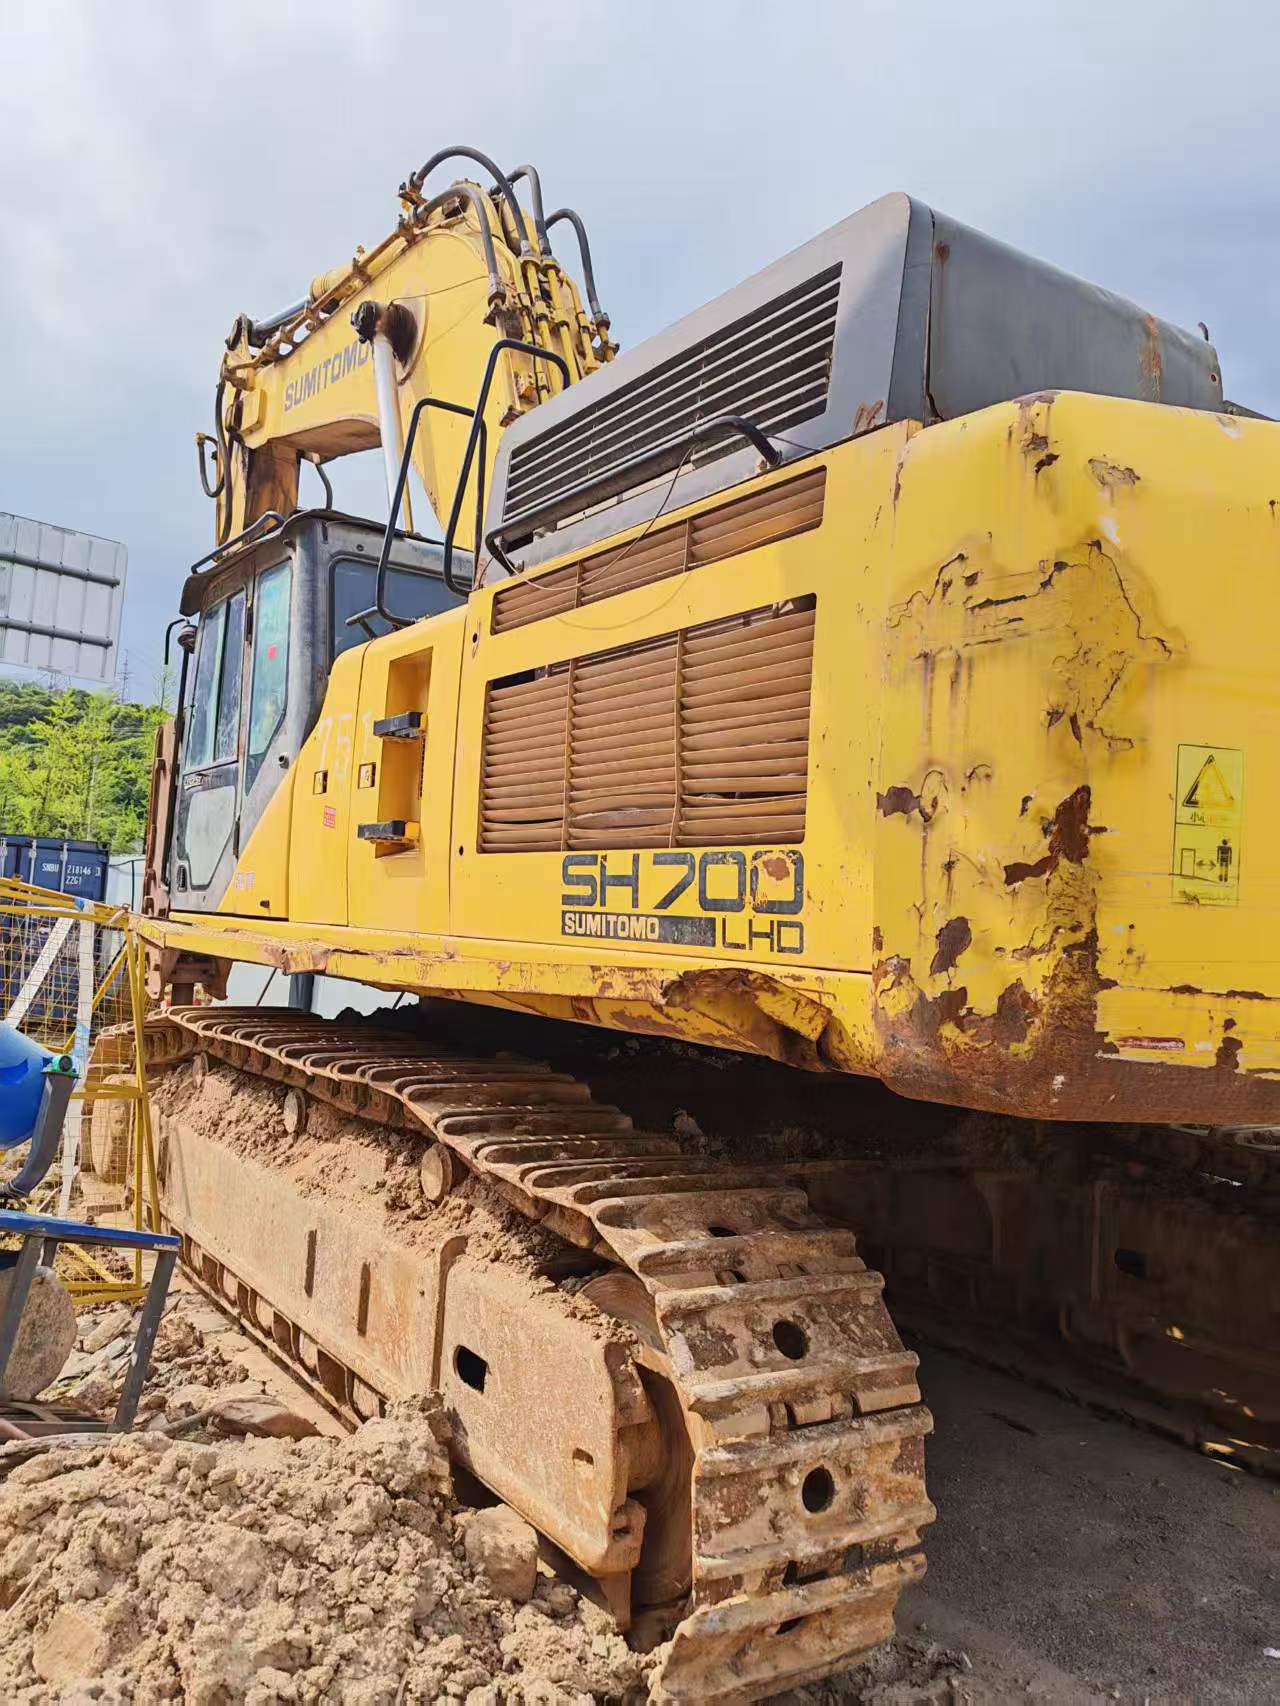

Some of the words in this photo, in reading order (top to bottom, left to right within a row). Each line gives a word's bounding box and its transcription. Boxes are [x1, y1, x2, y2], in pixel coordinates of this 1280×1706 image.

[284, 340, 369, 412] SUMITOMO
[564, 914, 660, 940] SUMITOMO
[721, 916, 805, 955] LHD
